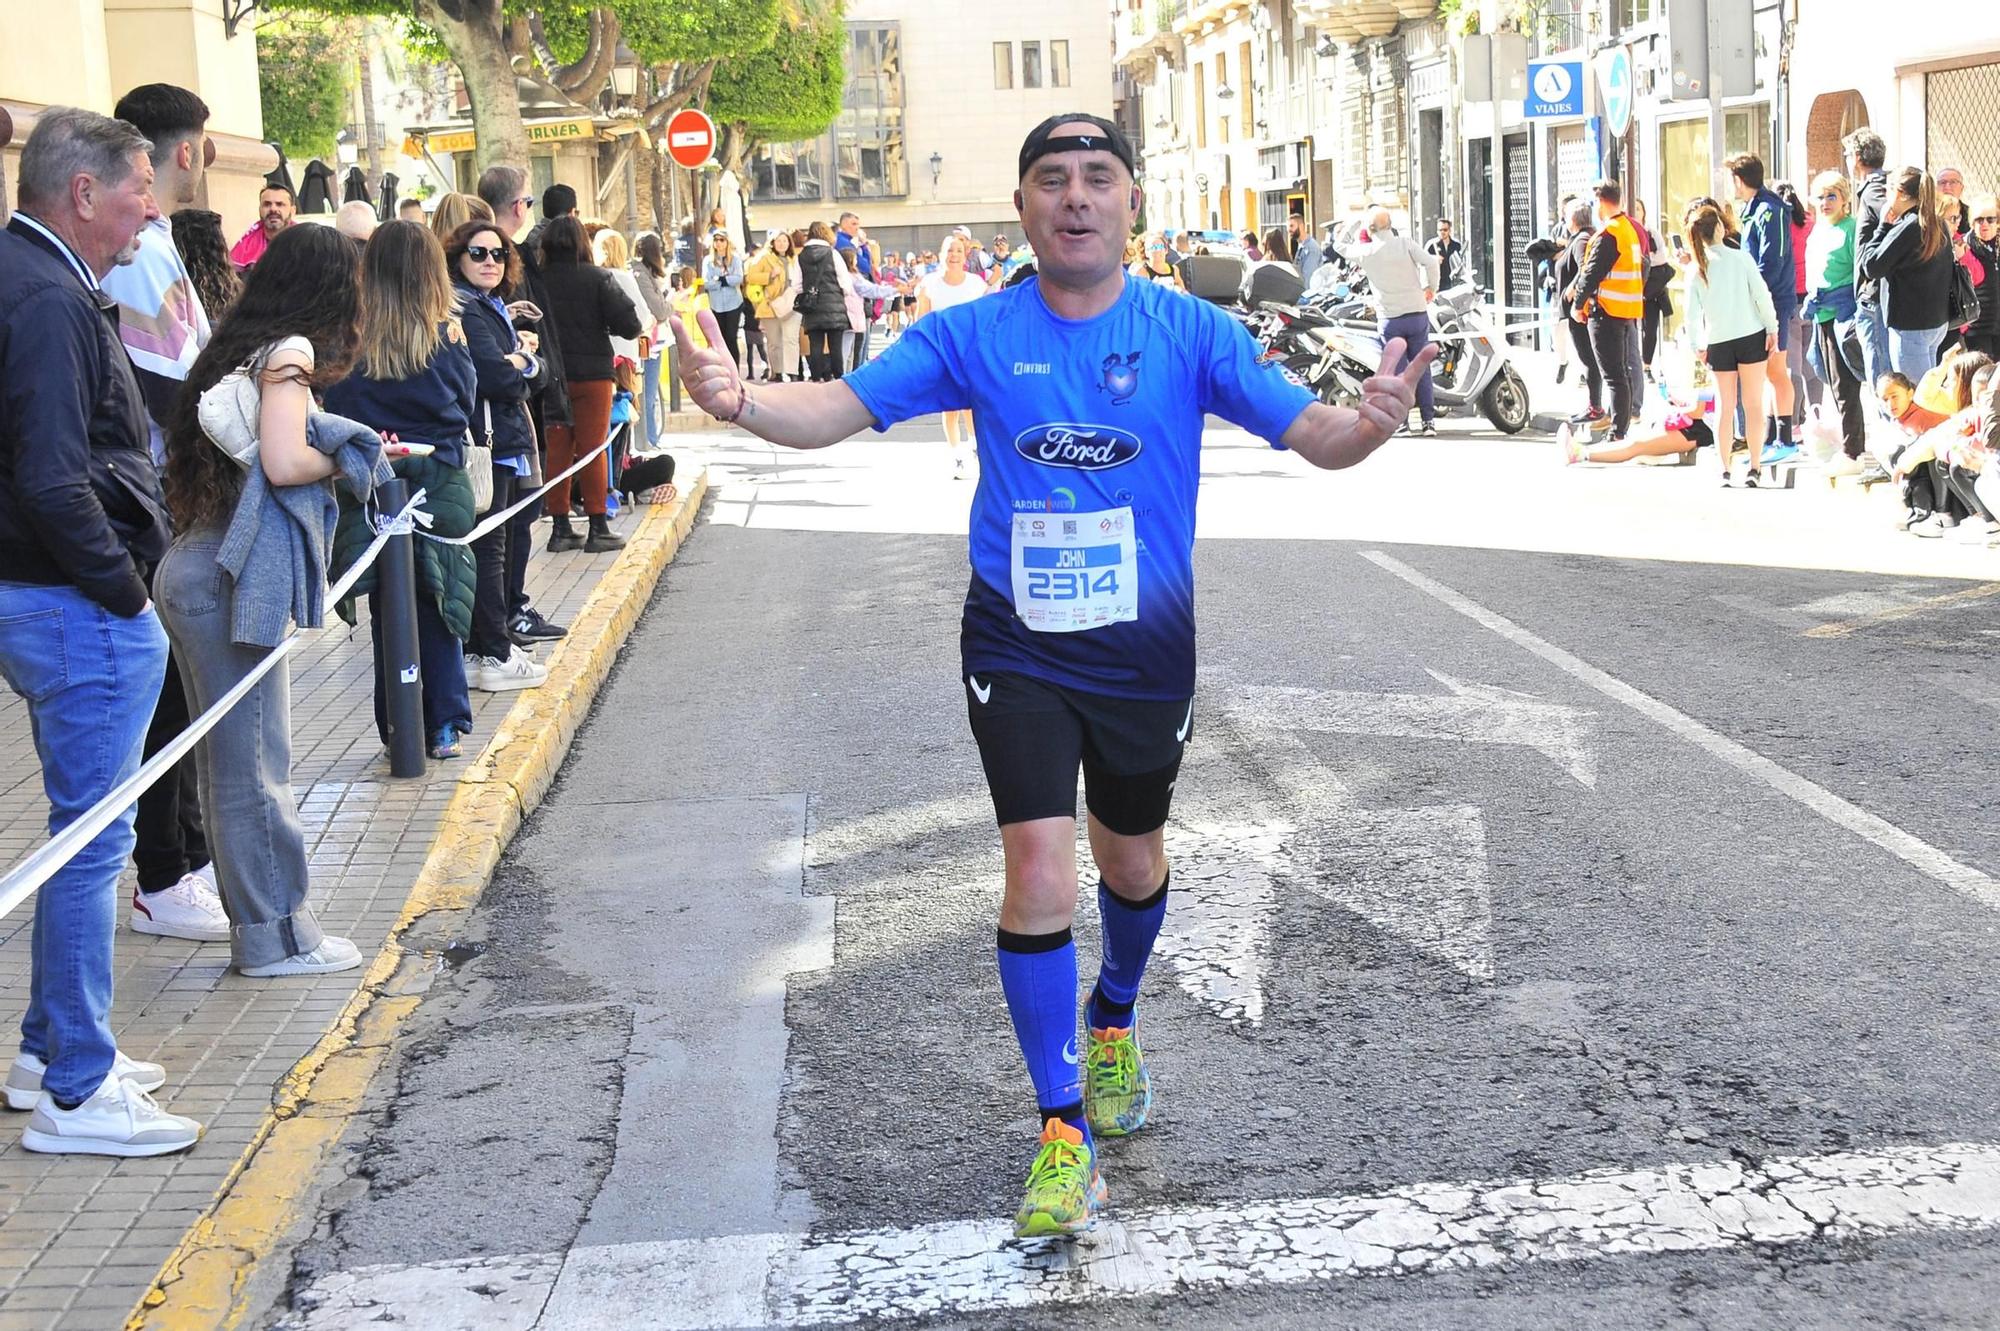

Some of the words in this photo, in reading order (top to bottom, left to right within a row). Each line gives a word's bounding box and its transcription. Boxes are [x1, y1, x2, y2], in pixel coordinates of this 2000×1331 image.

[1535, 103, 1572, 114] VIAJES
[1039, 427, 1117, 463] Ford
[1056, 549, 1086, 568] JOHN
[1028, 569, 1119, 600] 2314
